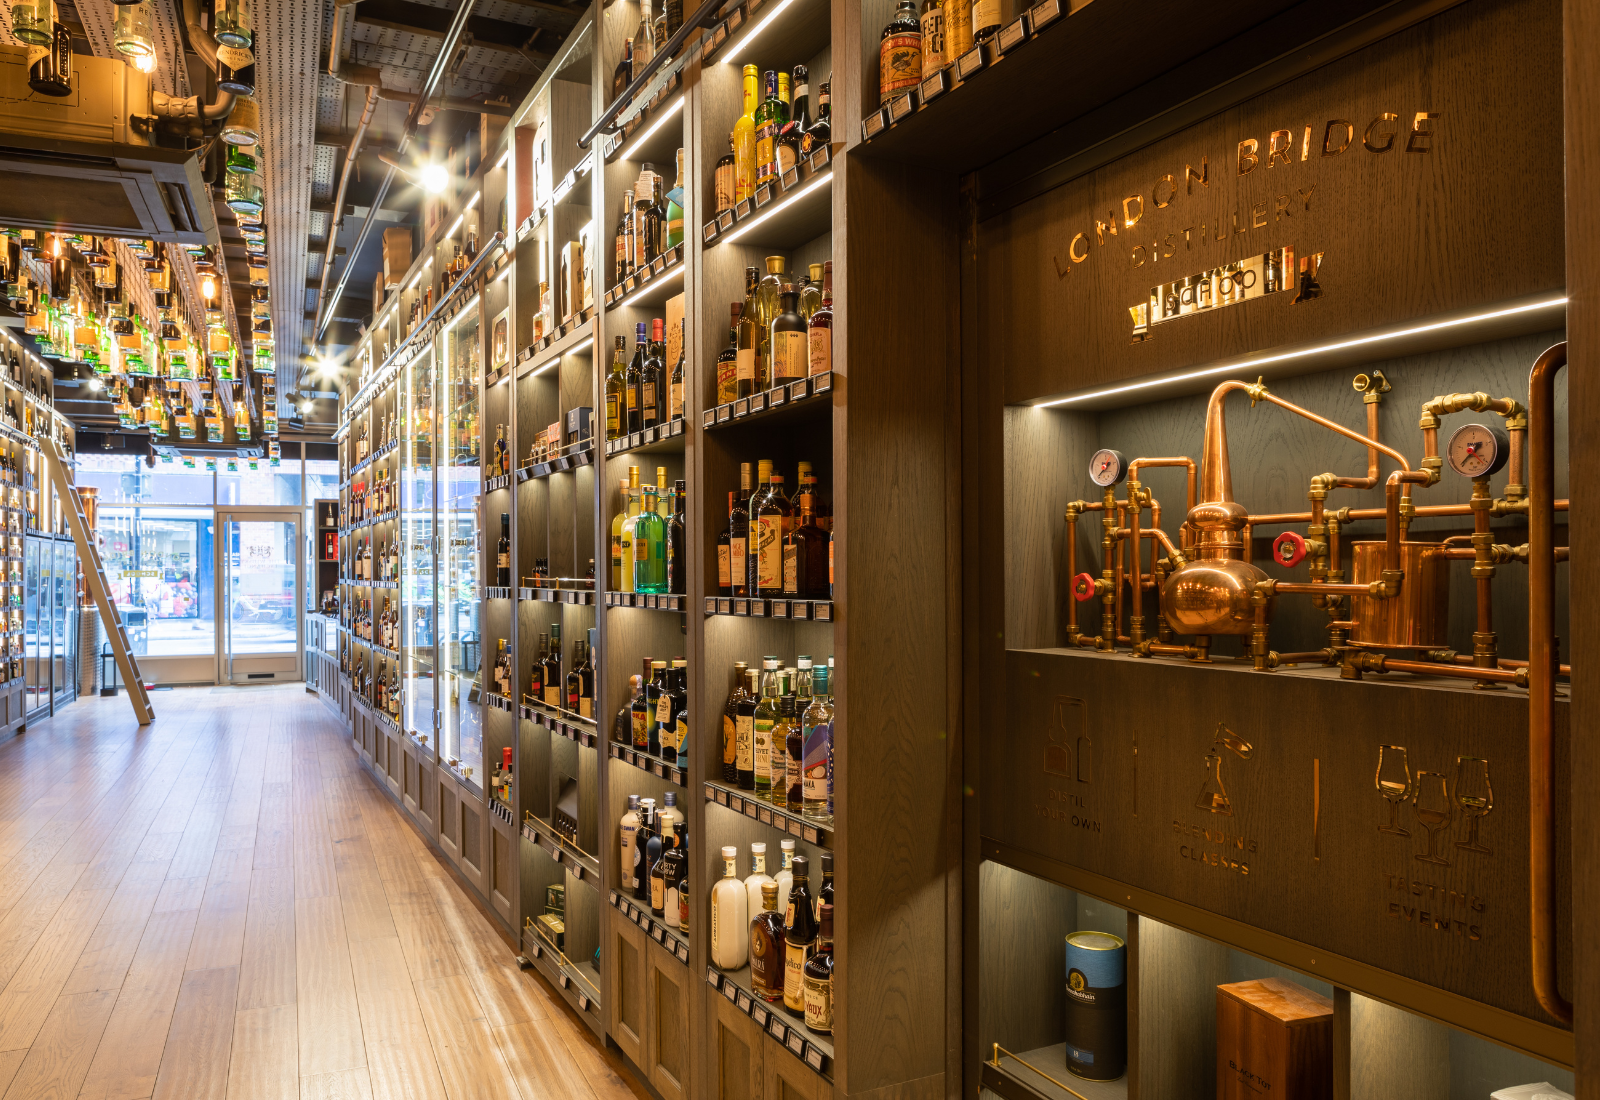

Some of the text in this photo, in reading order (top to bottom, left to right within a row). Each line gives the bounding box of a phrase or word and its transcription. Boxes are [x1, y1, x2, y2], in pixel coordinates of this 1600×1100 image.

[1053, 112, 1441, 281] LONDON BRIDGE
[1132, 182, 1319, 269] DISTILLERY
[1165, 264, 1270, 312] SCHOO
[1048, 787, 1086, 809] DISTIL
[1034, 803, 1102, 834] YOUR OWN
[1172, 819, 1259, 854] BLENDING
[1179, 845, 1251, 876] CLASSES
[1383, 872, 1486, 914] TASTING
[1388, 902, 1483, 941] EVENTS
[1229, 1059, 1255, 1081] BLACK
[1256, 1075, 1272, 1091] TOT
